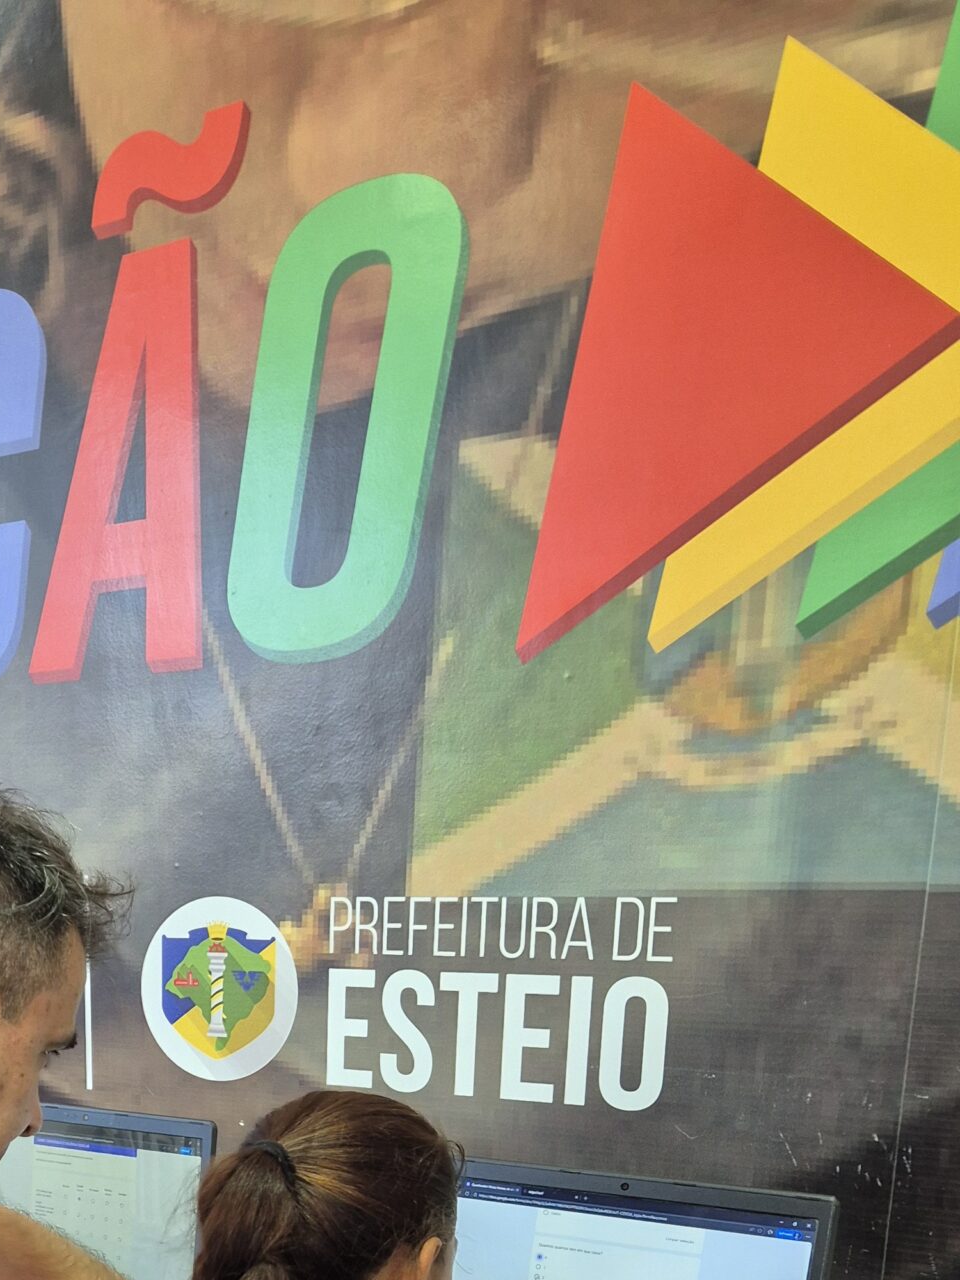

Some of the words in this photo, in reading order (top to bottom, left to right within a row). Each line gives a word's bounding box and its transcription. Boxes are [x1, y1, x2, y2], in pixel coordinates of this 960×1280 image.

[328, 896, 594, 961] PREFEITURA
[612, 896, 678, 962] DE
[326, 968, 670, 1112] ESTEIO
